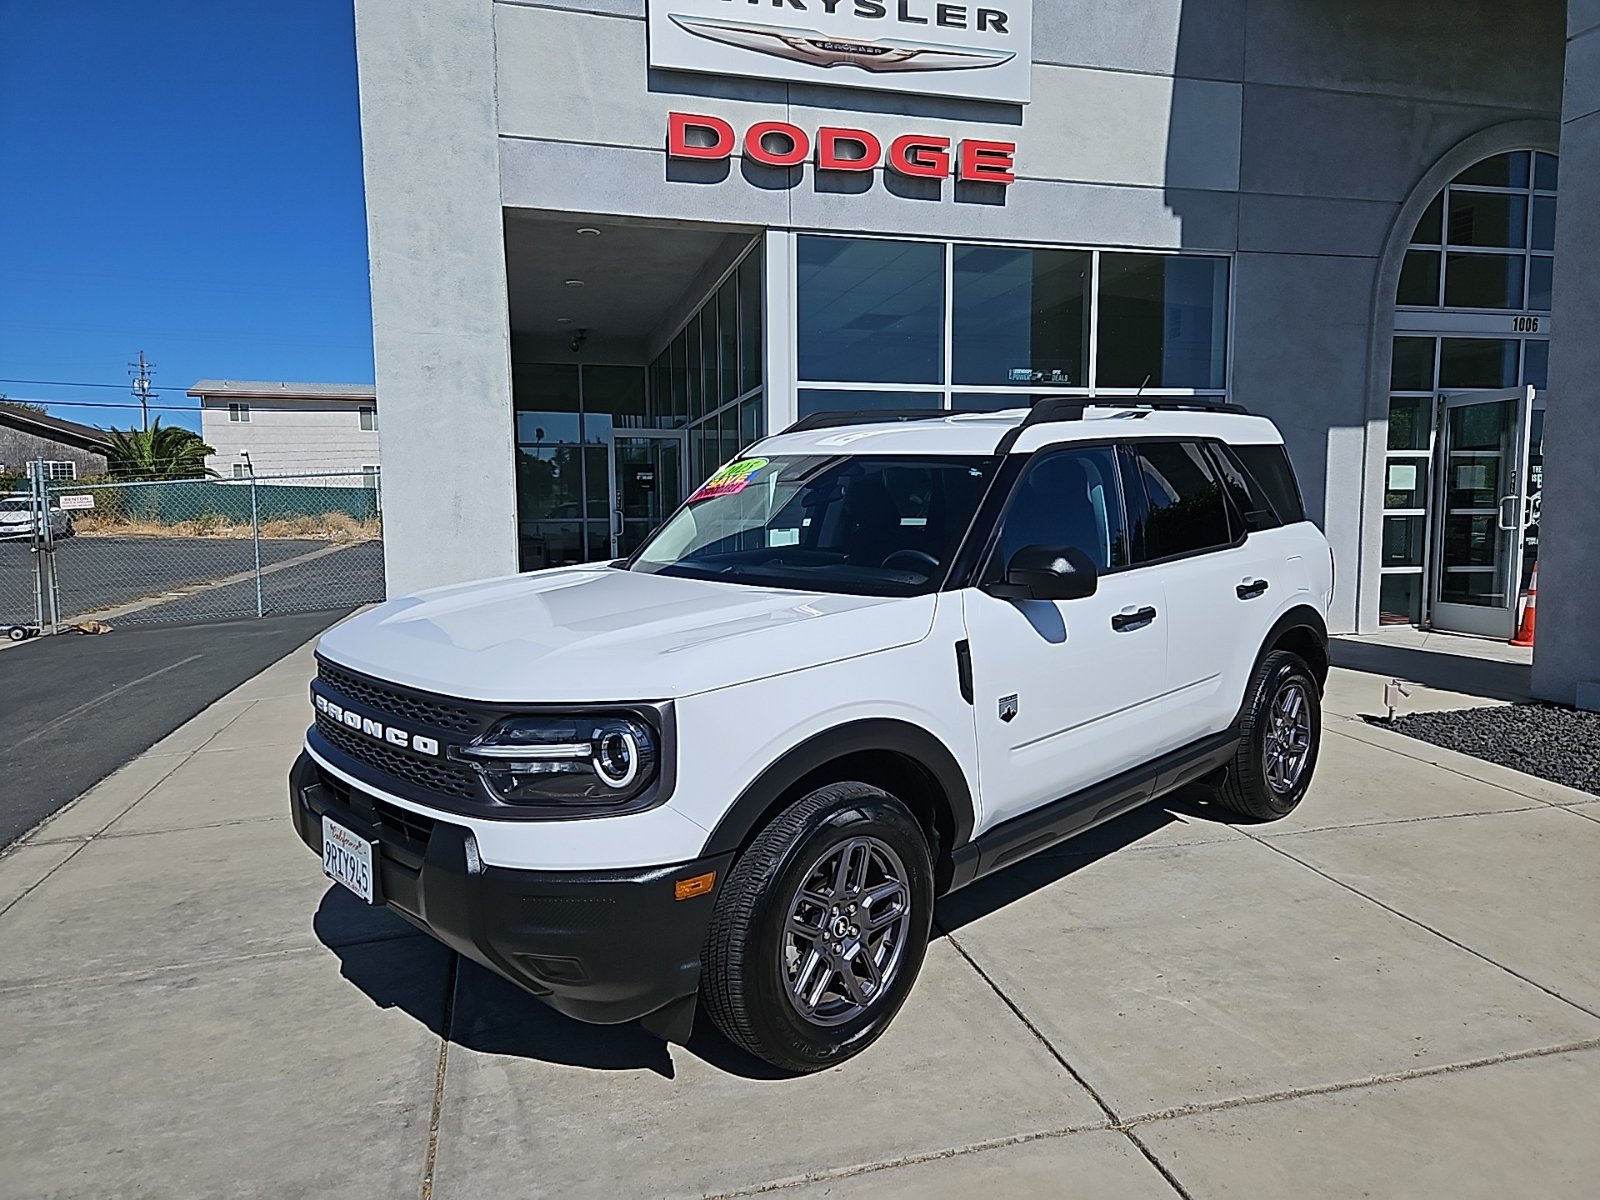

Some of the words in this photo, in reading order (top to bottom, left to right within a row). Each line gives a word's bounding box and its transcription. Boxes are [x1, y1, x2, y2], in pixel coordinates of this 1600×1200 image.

[667, 111, 1016, 184] DODGE
[1513, 316, 1539, 333] 1006
[315, 694, 439, 756] BRONCO
